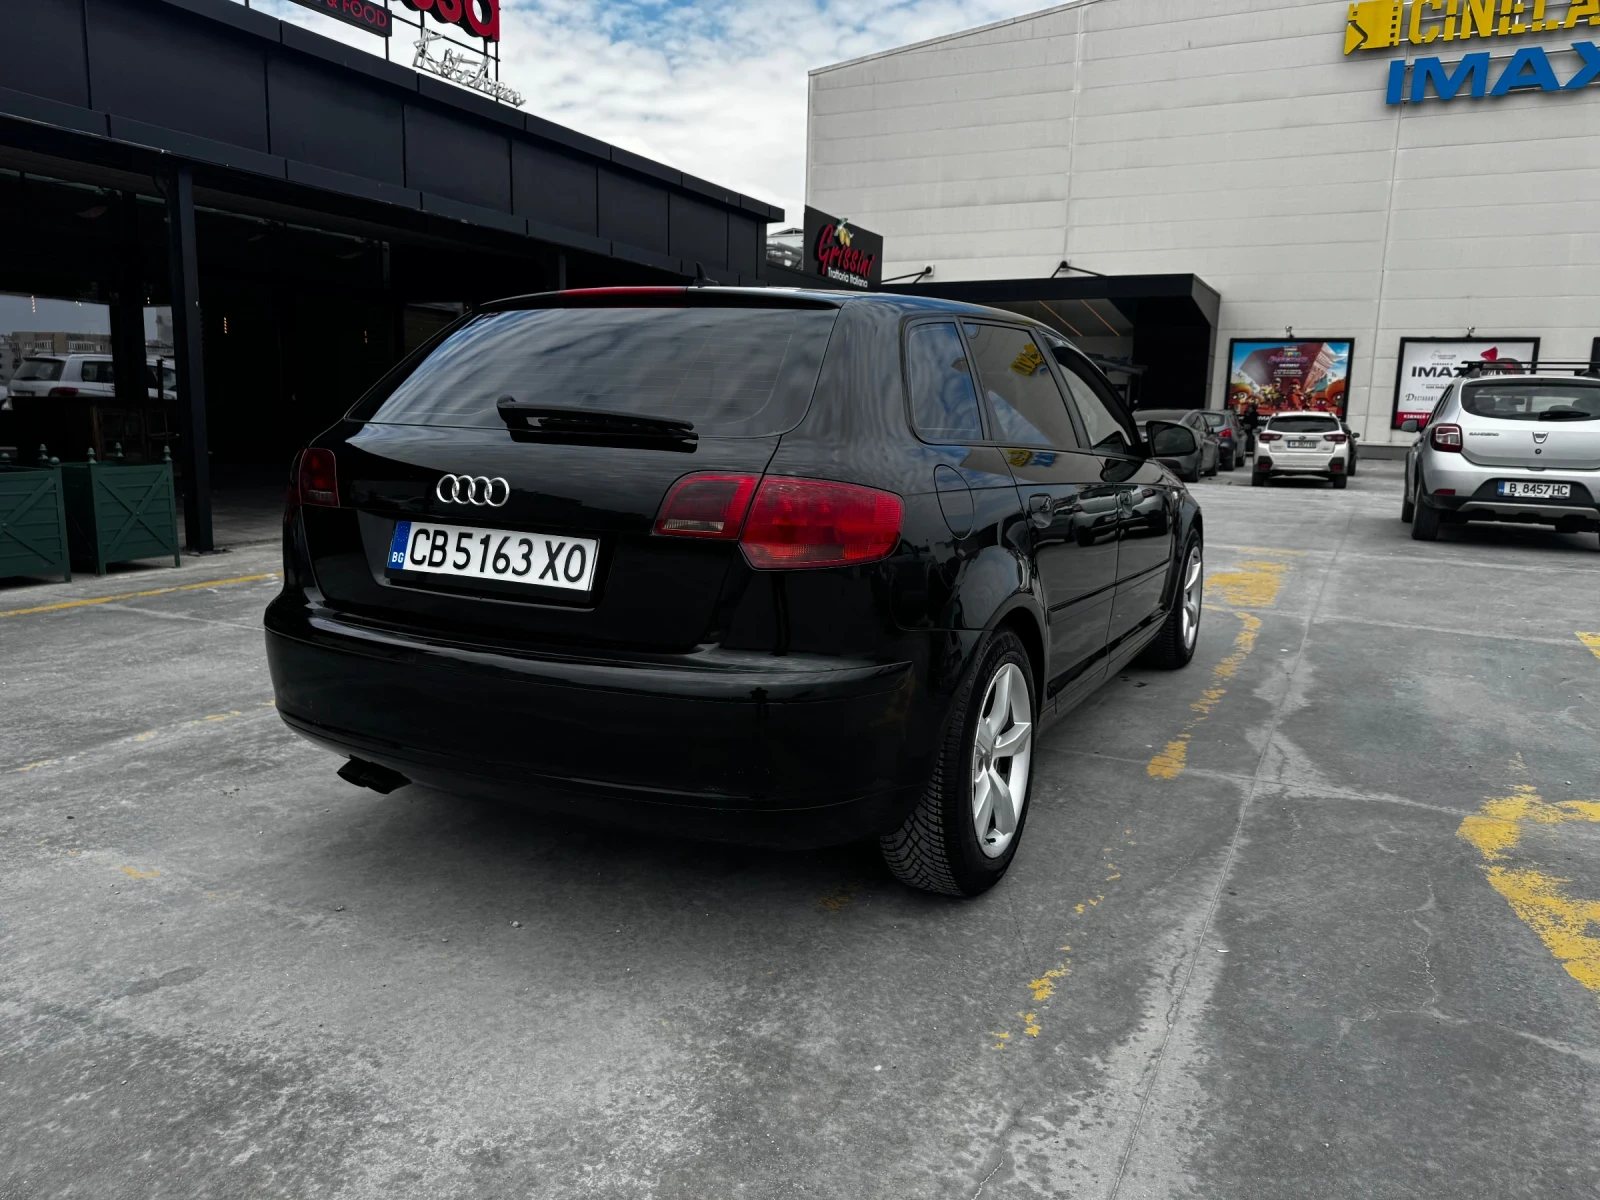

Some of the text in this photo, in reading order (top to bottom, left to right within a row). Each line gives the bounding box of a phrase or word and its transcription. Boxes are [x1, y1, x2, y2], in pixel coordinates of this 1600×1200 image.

[343, 0, 387, 27] FOOD
[818, 223, 876, 278] Grissini
[391, 551, 405, 564] BG
